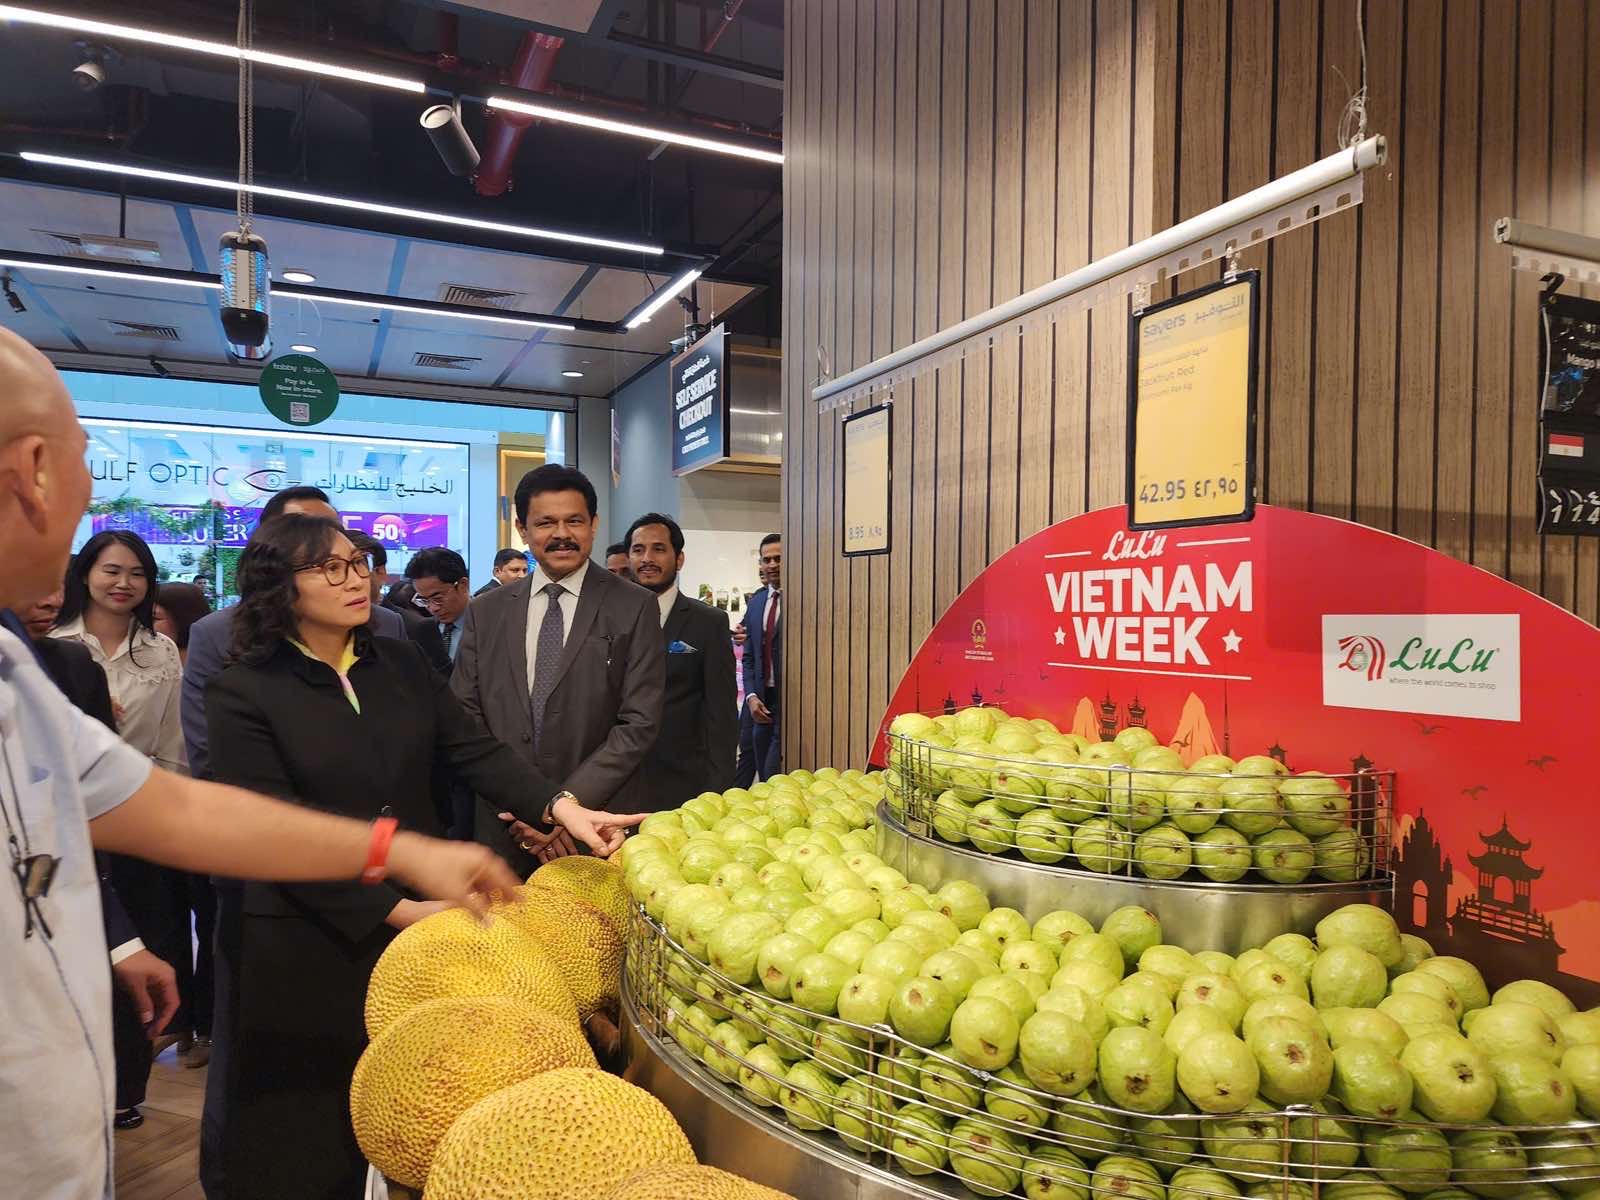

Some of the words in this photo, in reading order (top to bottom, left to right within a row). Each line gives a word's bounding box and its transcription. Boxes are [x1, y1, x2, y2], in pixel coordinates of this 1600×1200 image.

[90, 460, 137, 482] ULF
[149, 463, 229, 486] OPTIC
[396, 478, 453, 497] الخليج
[1139, 479, 1186, 503] 42.95
[1102, 530, 1168, 561] LuLu
[1045, 561, 1253, 613] VIETNAM
[1072, 616, 1211, 666] WEEK
[1389, 637, 1495, 673] LuLu
[1411, 678, 1422, 686] the
